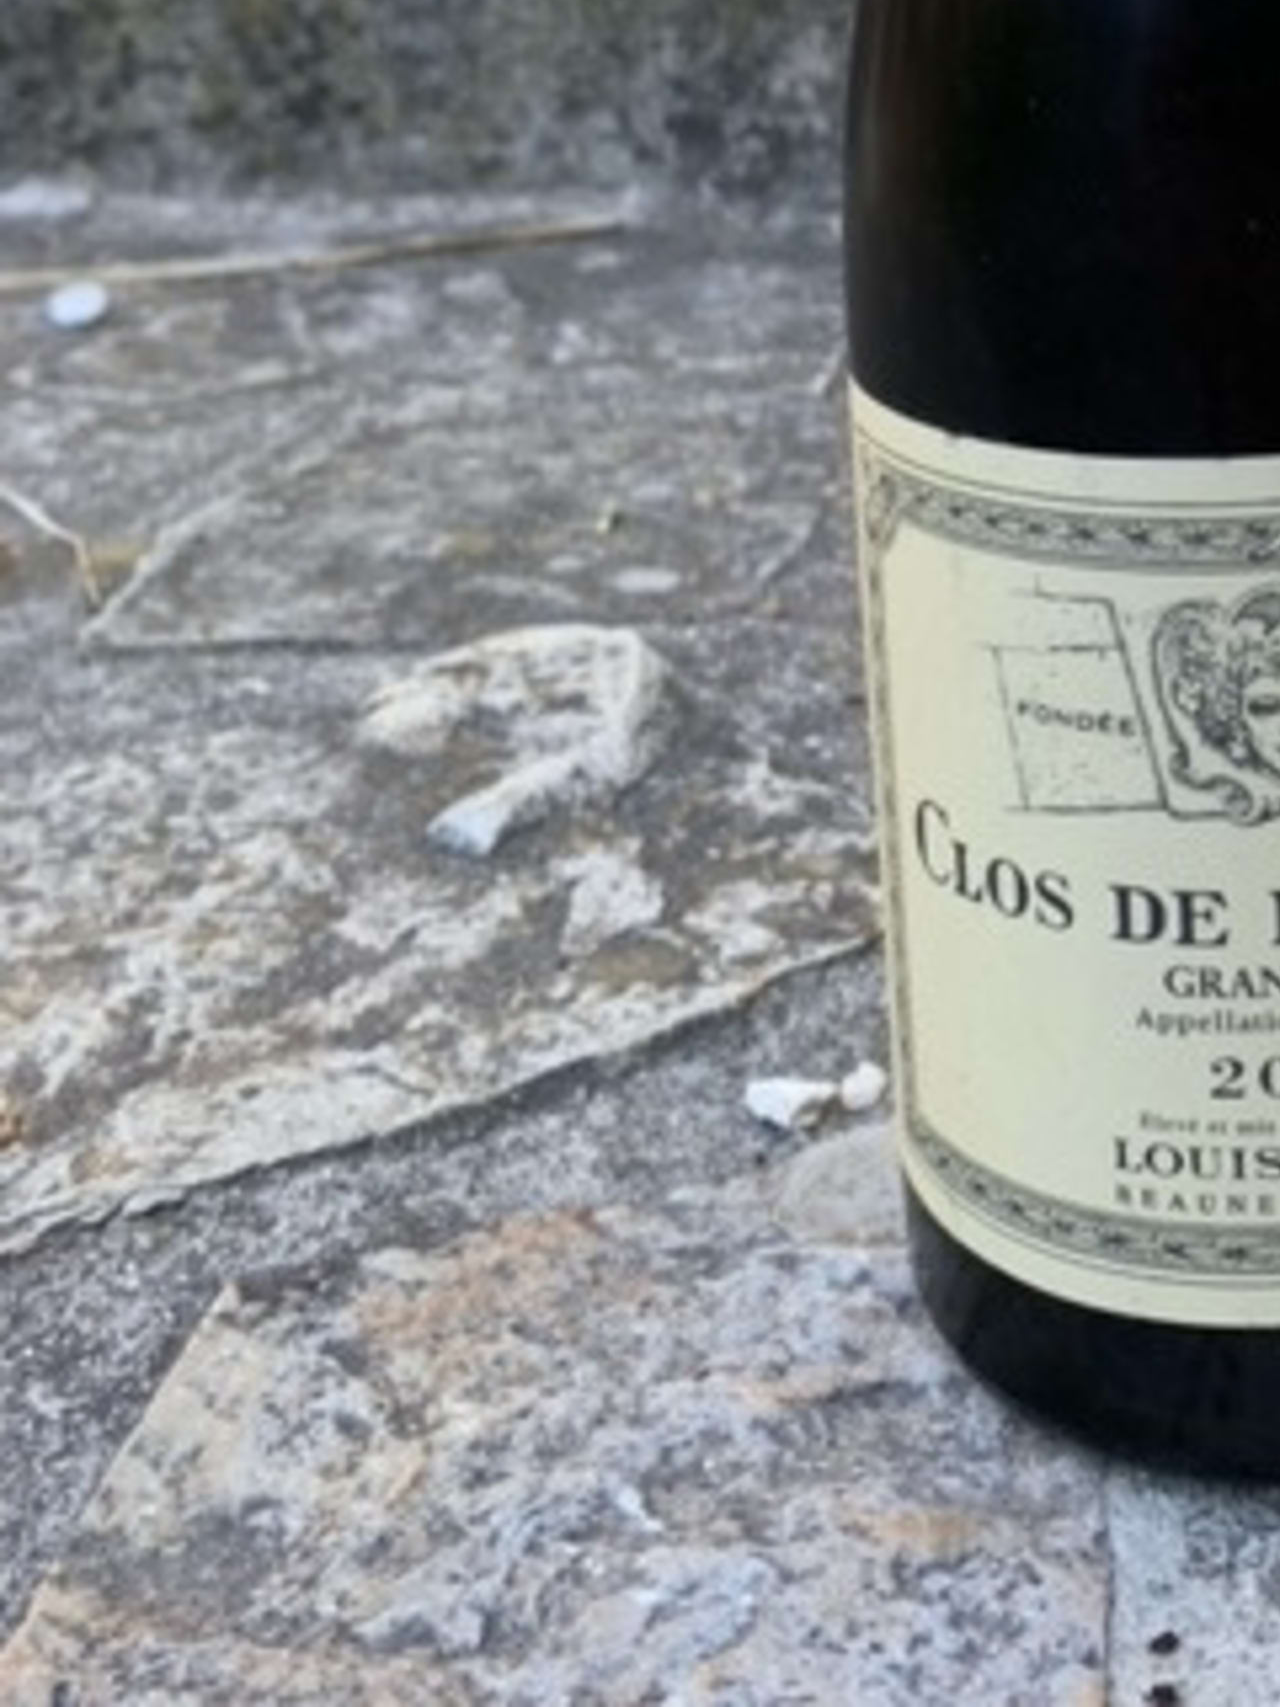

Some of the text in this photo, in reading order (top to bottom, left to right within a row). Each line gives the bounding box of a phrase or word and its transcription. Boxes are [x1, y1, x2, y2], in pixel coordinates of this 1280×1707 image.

[915, 799, 1073, 931] CLOS
[1109, 884, 1229, 946] DE
[1115, 1183, 1276, 1216] BEAUNE
